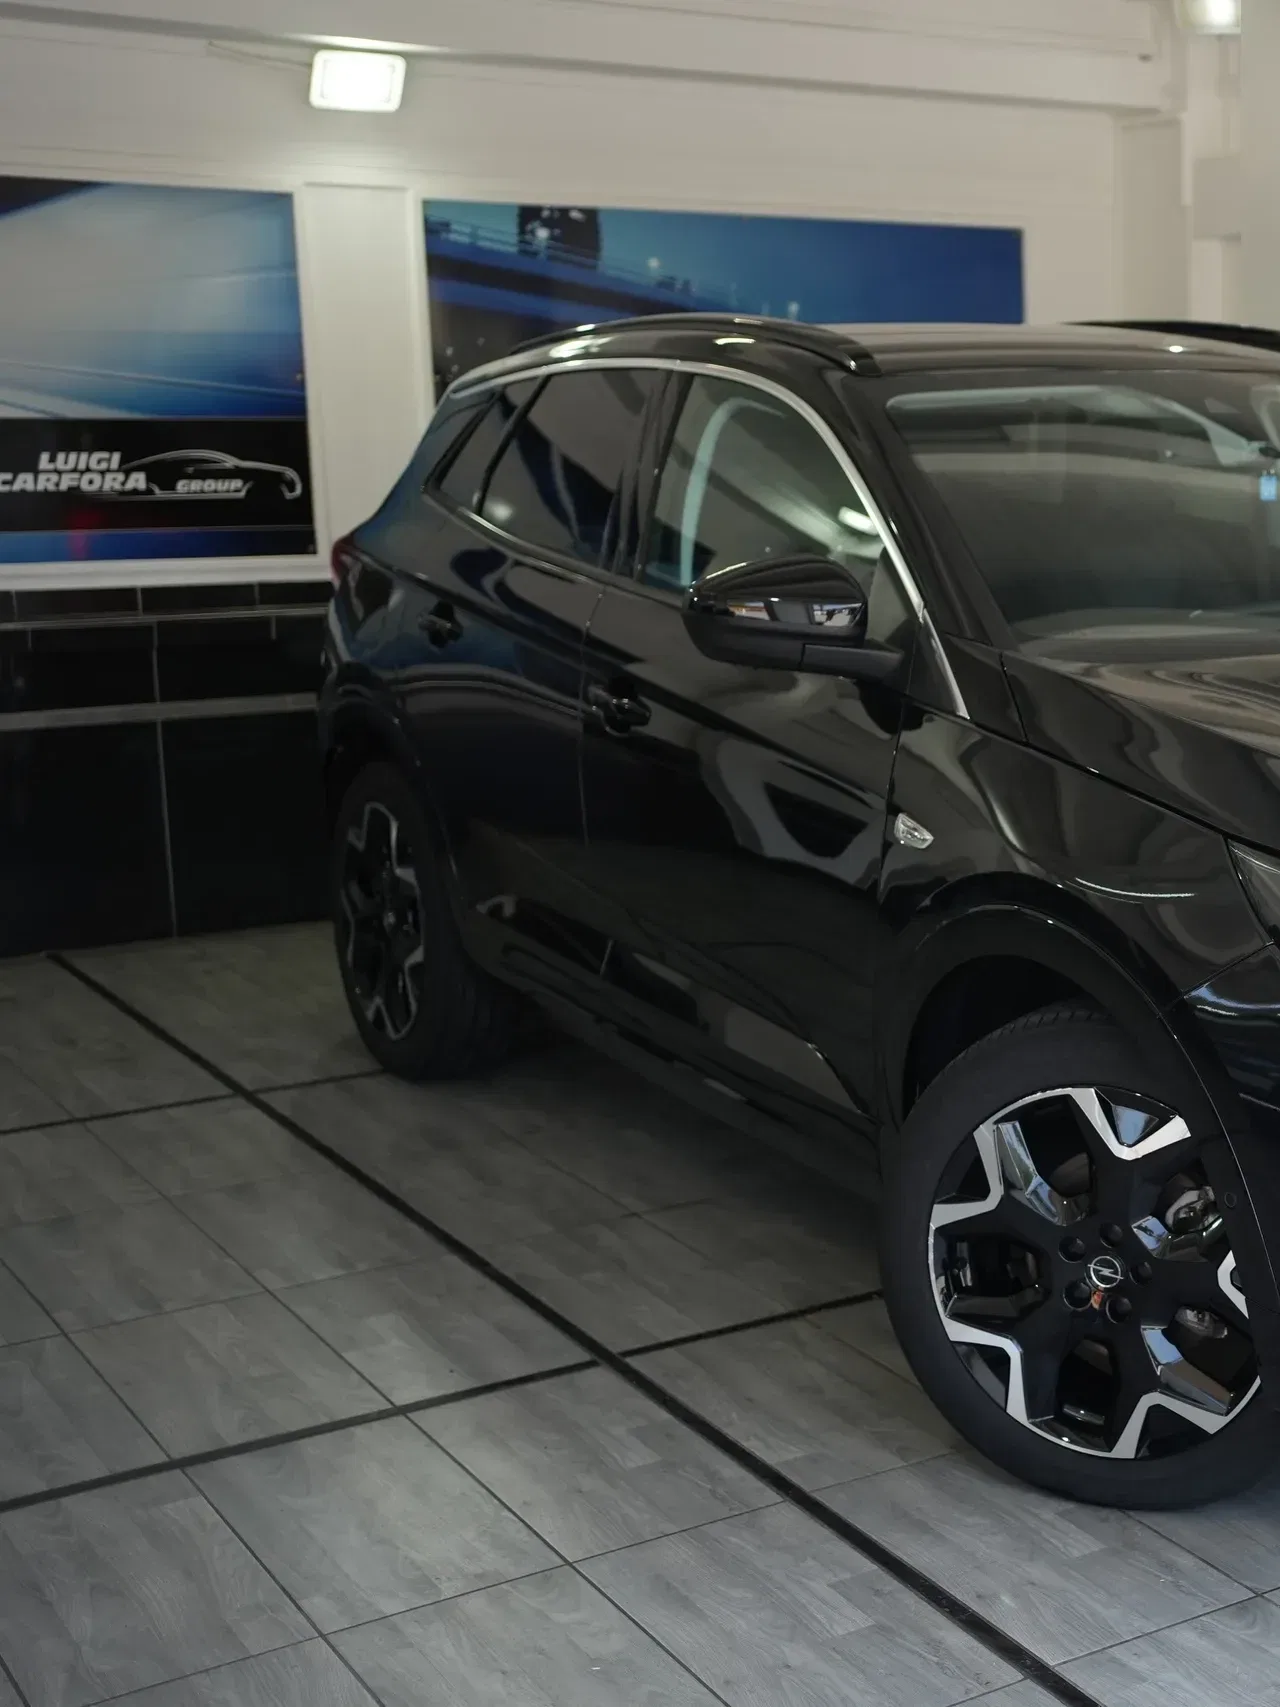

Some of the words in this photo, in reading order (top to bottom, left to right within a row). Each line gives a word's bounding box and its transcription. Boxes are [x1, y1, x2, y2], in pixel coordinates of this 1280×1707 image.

[38, 451, 121, 471] LUIGI
[0, 471, 147, 492] CARFORA
[175, 478, 243, 493] GROUP
